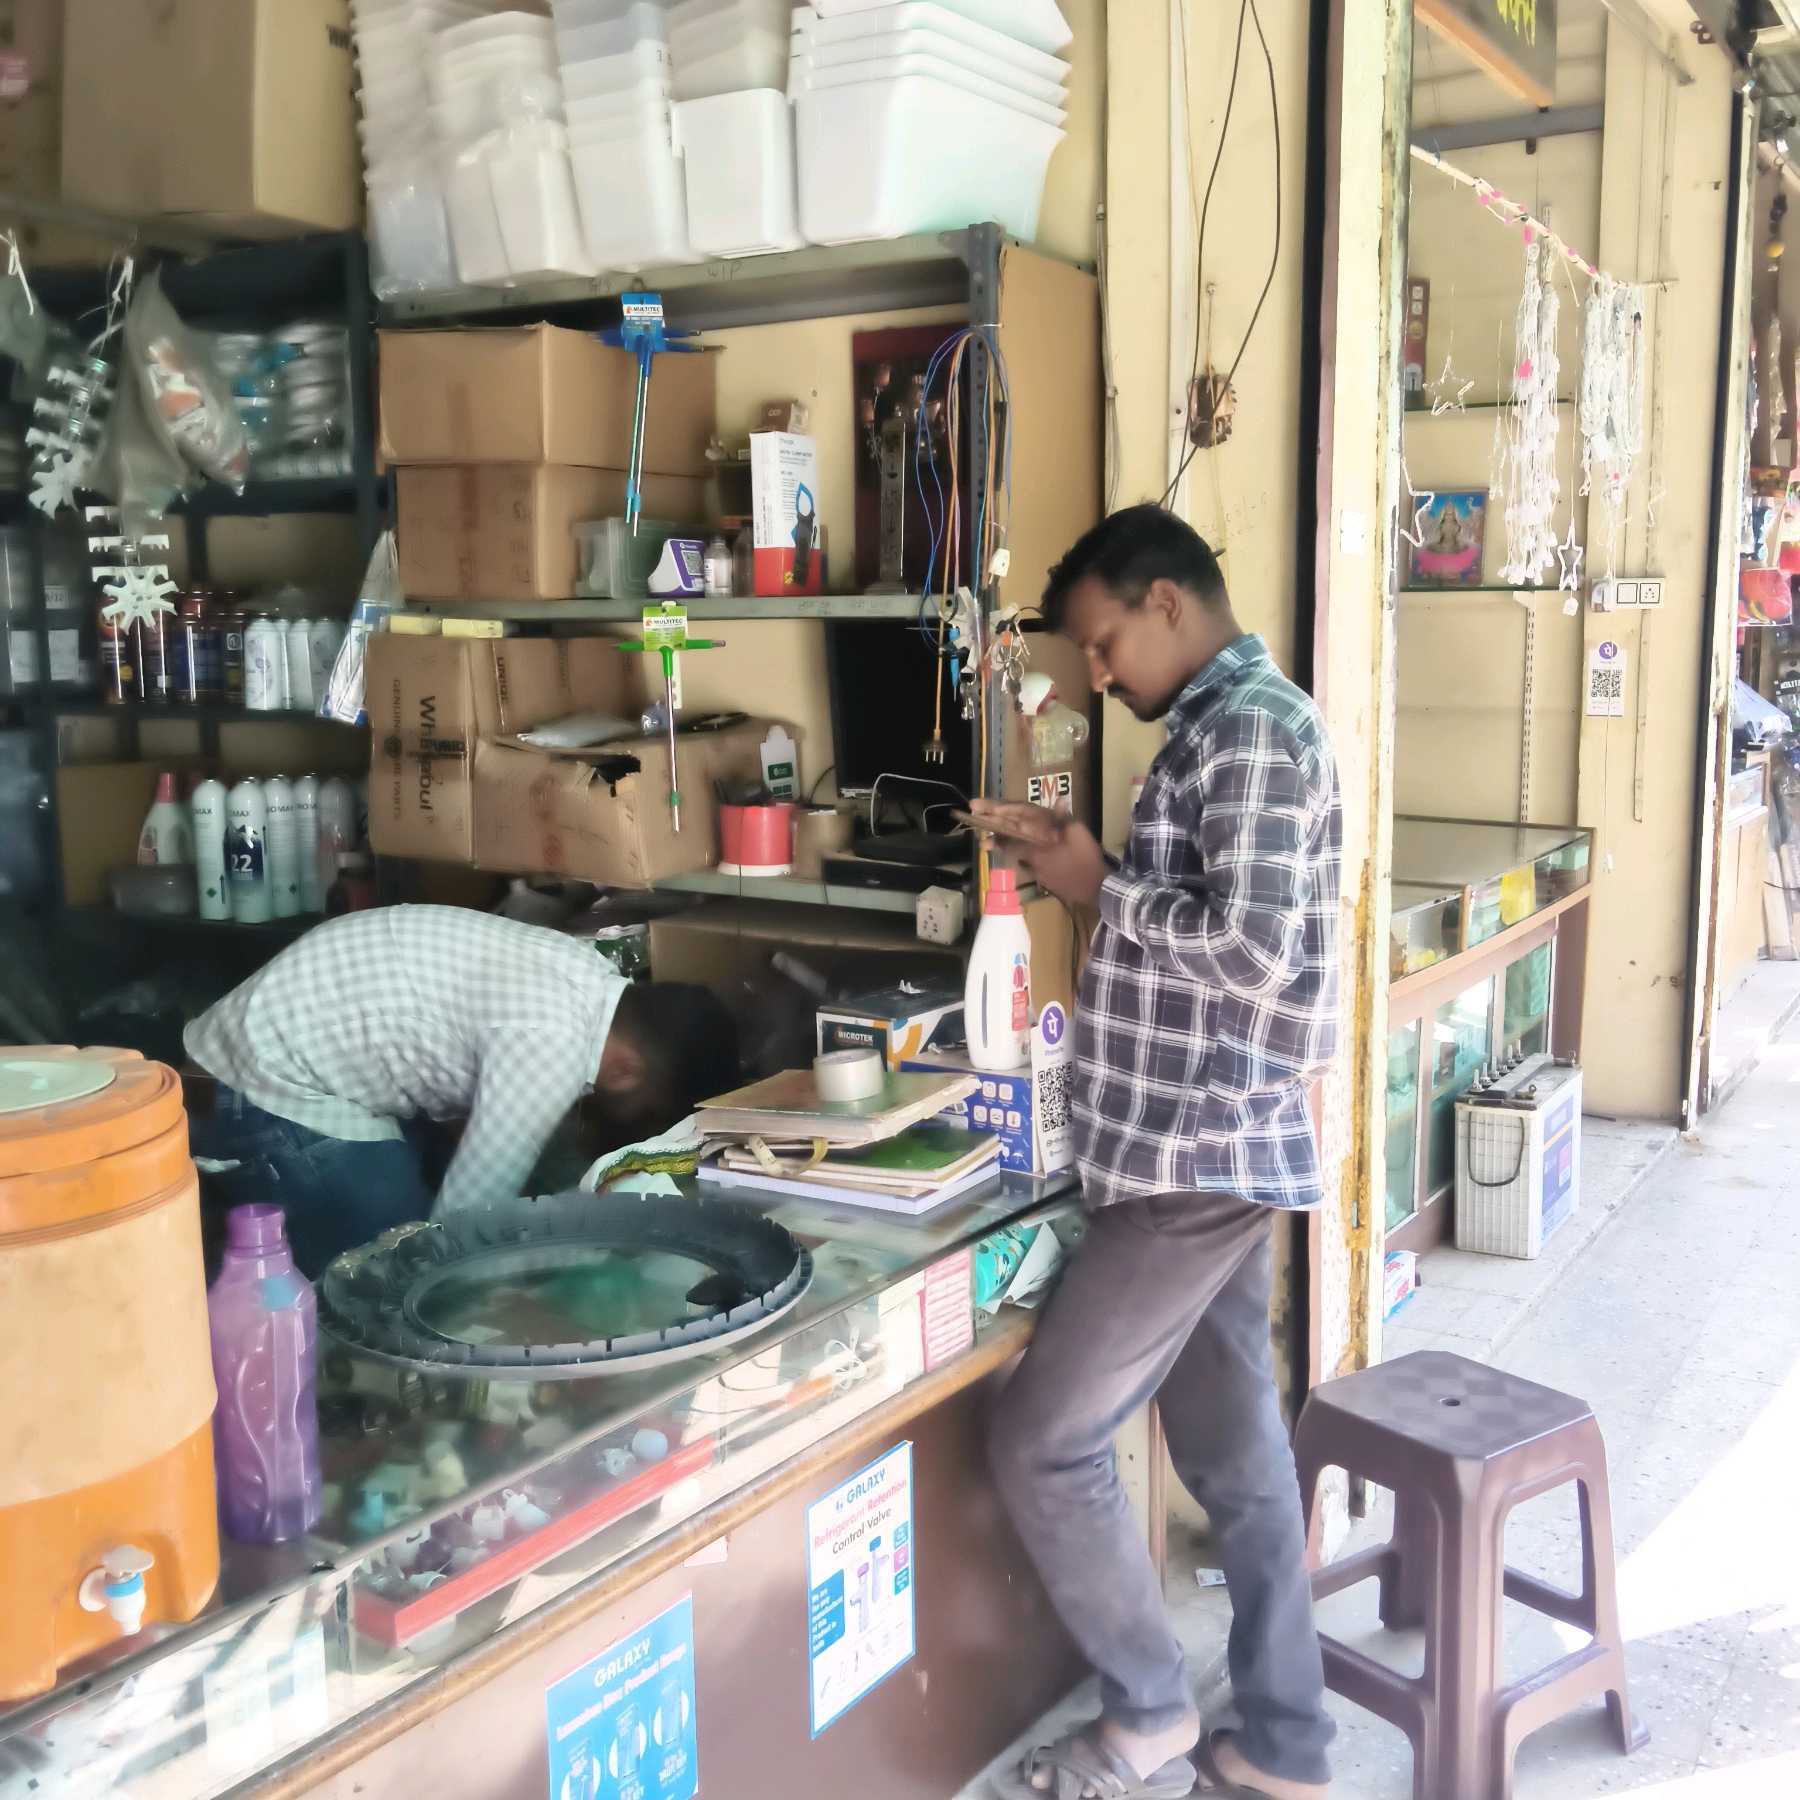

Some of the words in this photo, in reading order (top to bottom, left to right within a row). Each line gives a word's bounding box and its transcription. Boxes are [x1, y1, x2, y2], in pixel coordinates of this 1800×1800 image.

[846, 1467, 886, 1504] GALAXY
[832, 1522, 865, 1554] Control
[866, 1508, 892, 1529] Valve
[593, 1637, 652, 1688] GALAXY
